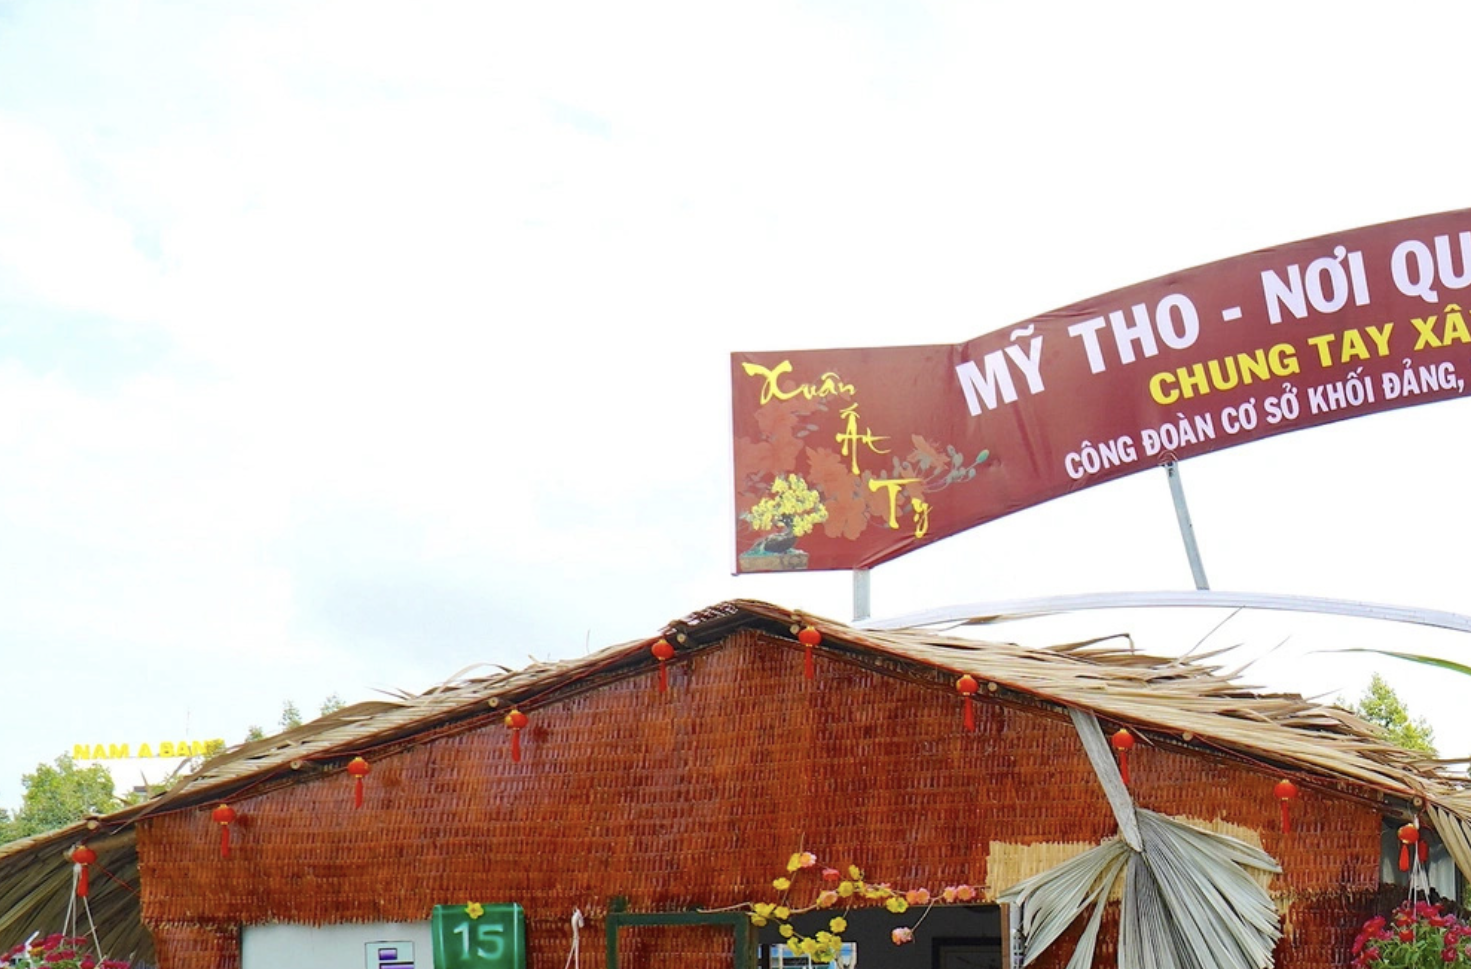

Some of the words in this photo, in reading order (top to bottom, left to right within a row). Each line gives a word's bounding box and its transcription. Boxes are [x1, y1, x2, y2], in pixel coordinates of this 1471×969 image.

[956, 324, 1047, 416] MỸ
[1068, 292, 1200, 374] THO
[1221, 304, 1242, 322] -
[1261, 245, 1370, 325] NƠI
[741, 360, 856, 405] Xuân
[1148, 342, 1300, 405] CHUNG
[1307, 322, 1394, 368] TAY
[1064, 435, 1138, 480] CÔNG
[1141, 412, 1216, 457] ĐOÀN
[1221, 397, 1258, 435] CƠ
[1263, 382, 1300, 425] SỞ
[1306, 366, 1376, 415] KHỐI
[1381, 358, 1465, 401] ĐẢNG,
[73, 743, 130, 760] NAM
[453, 921, 505, 960] 15
